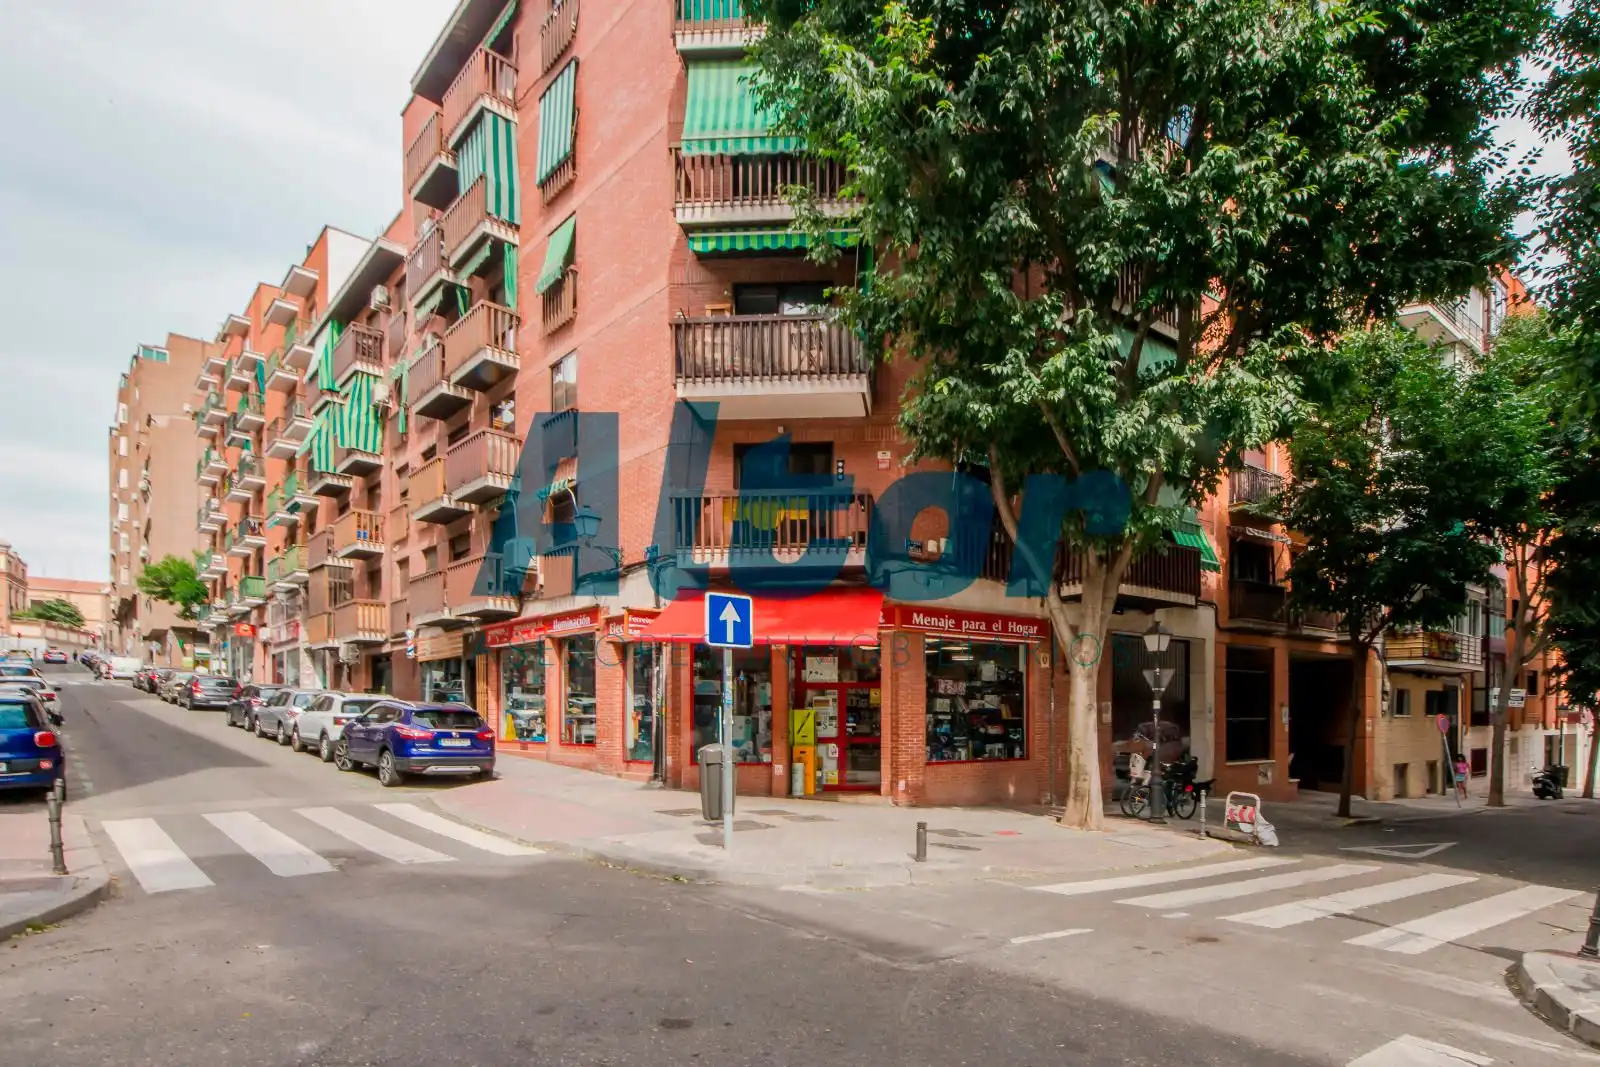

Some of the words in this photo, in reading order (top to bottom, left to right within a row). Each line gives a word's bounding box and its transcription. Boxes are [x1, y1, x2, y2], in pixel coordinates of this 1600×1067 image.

[912, 612, 955, 631] Menaje
[962, 618, 986, 632] para
[992, 619, 1002, 631] el
[1008, 620, 1039, 636] Hogar
